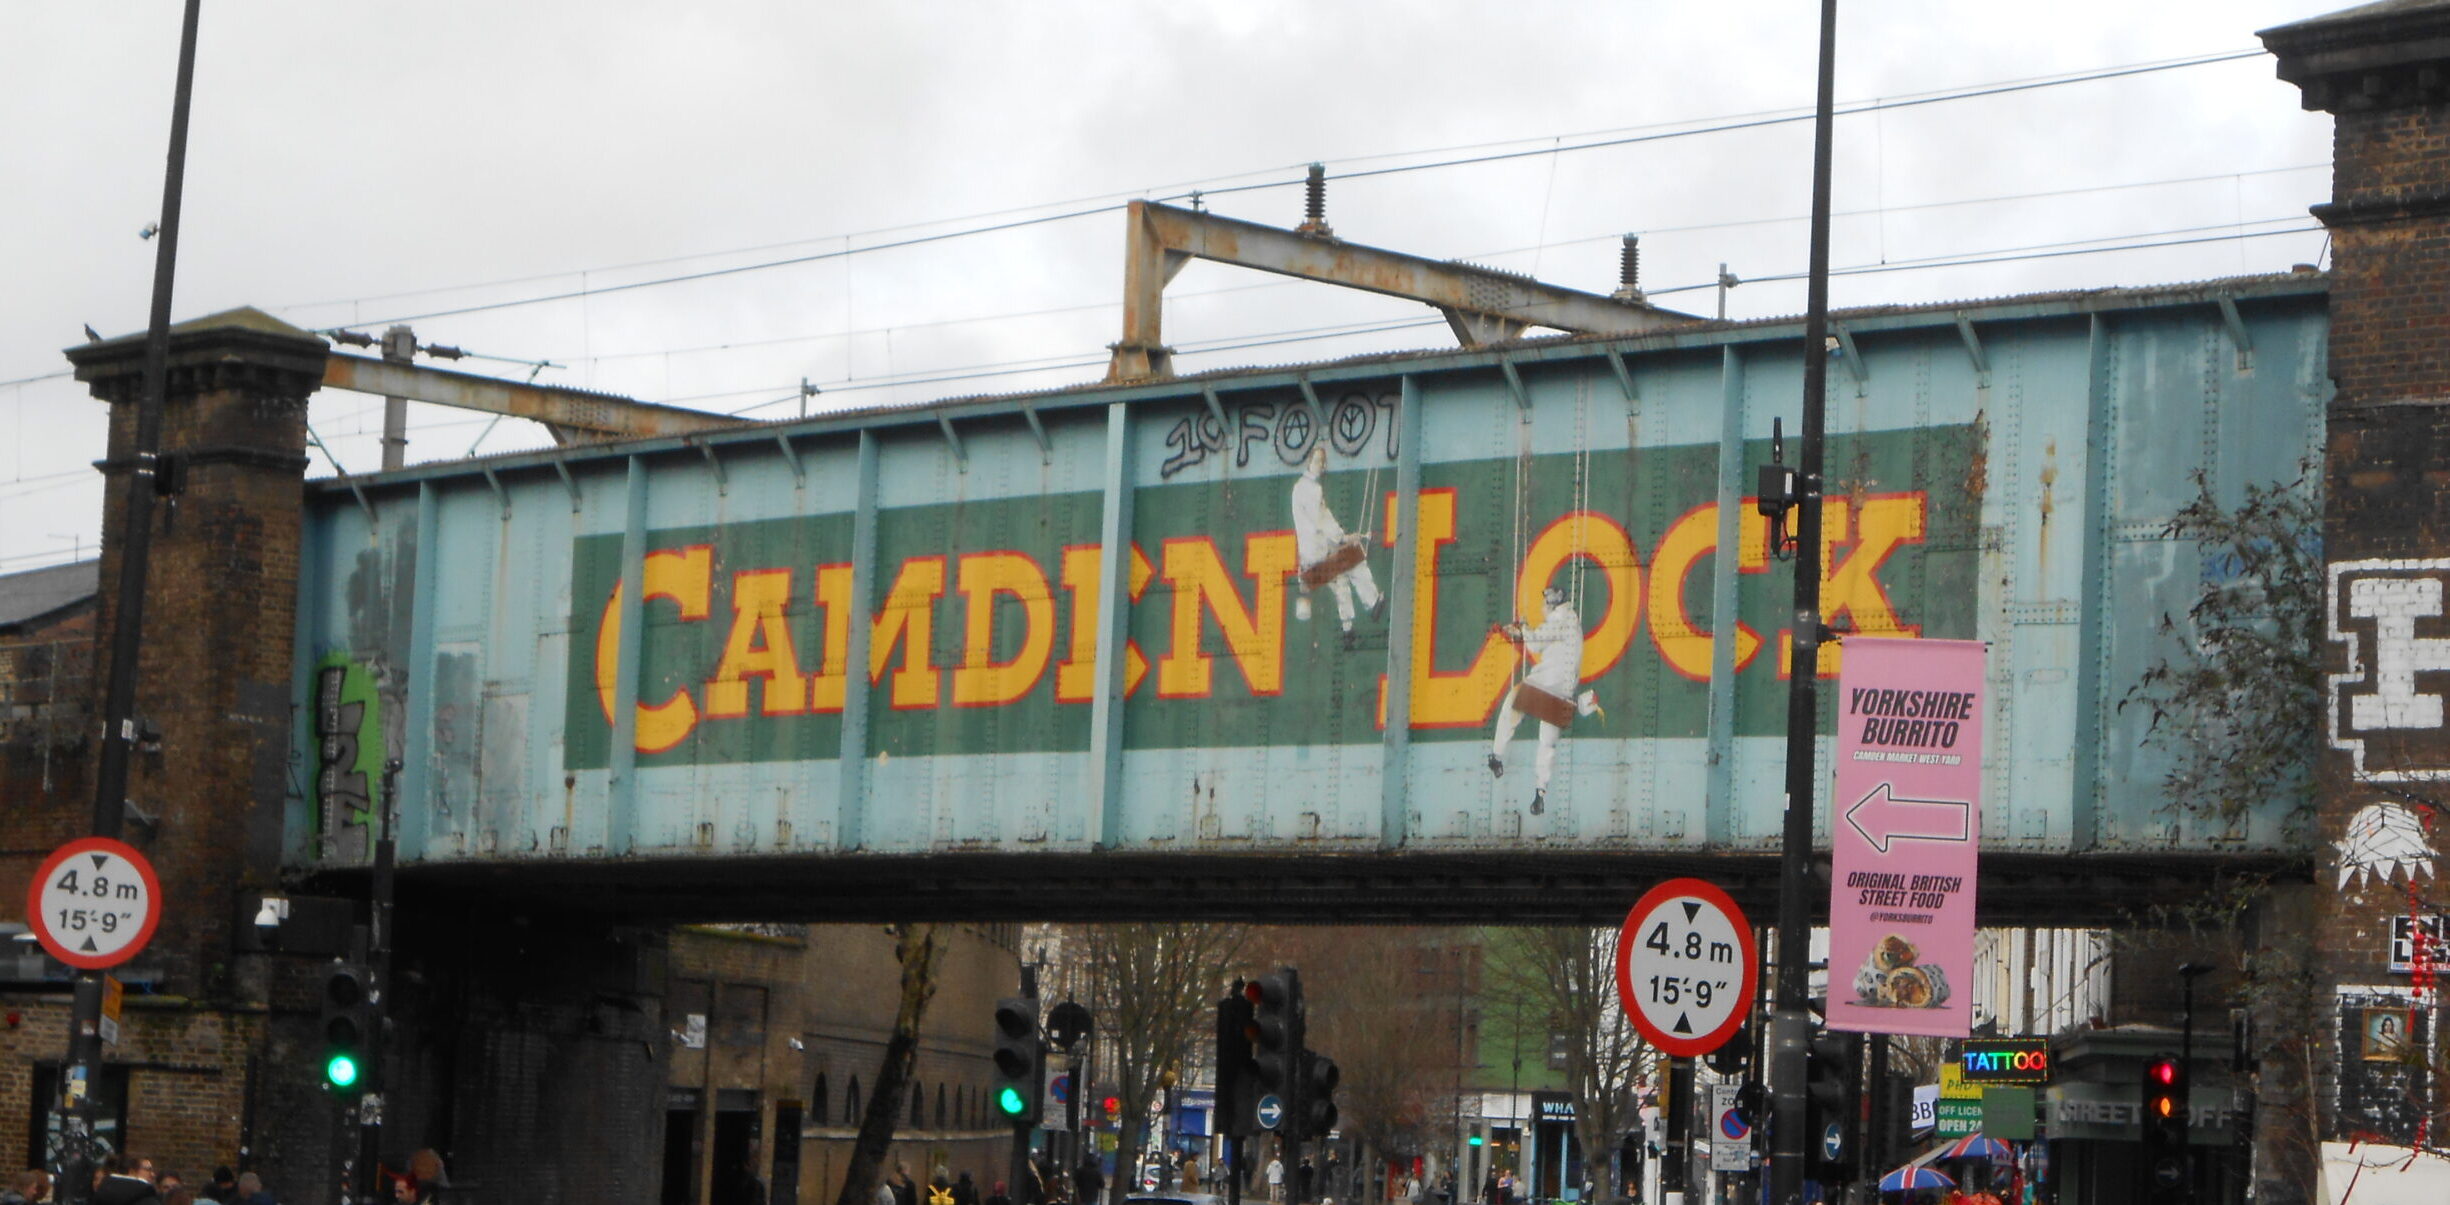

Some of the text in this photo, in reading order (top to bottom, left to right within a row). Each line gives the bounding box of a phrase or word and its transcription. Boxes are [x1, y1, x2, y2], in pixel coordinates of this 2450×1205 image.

[595, 486, 1927, 755] CAMDEN LOCK
[1850, 688, 1975, 720] YORKSHIRE
[1861, 718, 1960, 748] BURRITO
[1853, 751, 1961, 765] CAMDEN MARKET WEST YARD
[57, 869, 138, 900] 4.8 m
[1847, 872, 1962, 893] ORIGINAL BRITISH
[1859, 890, 1945, 909] STREET FOOD
[1646, 921, 1733, 964] 4.8 m
[1963, 1051, 2045, 1071] TATTOO
[1938, 1105, 1956, 1115] OFF
[1938, 1119, 1967, 1132] OPEN
